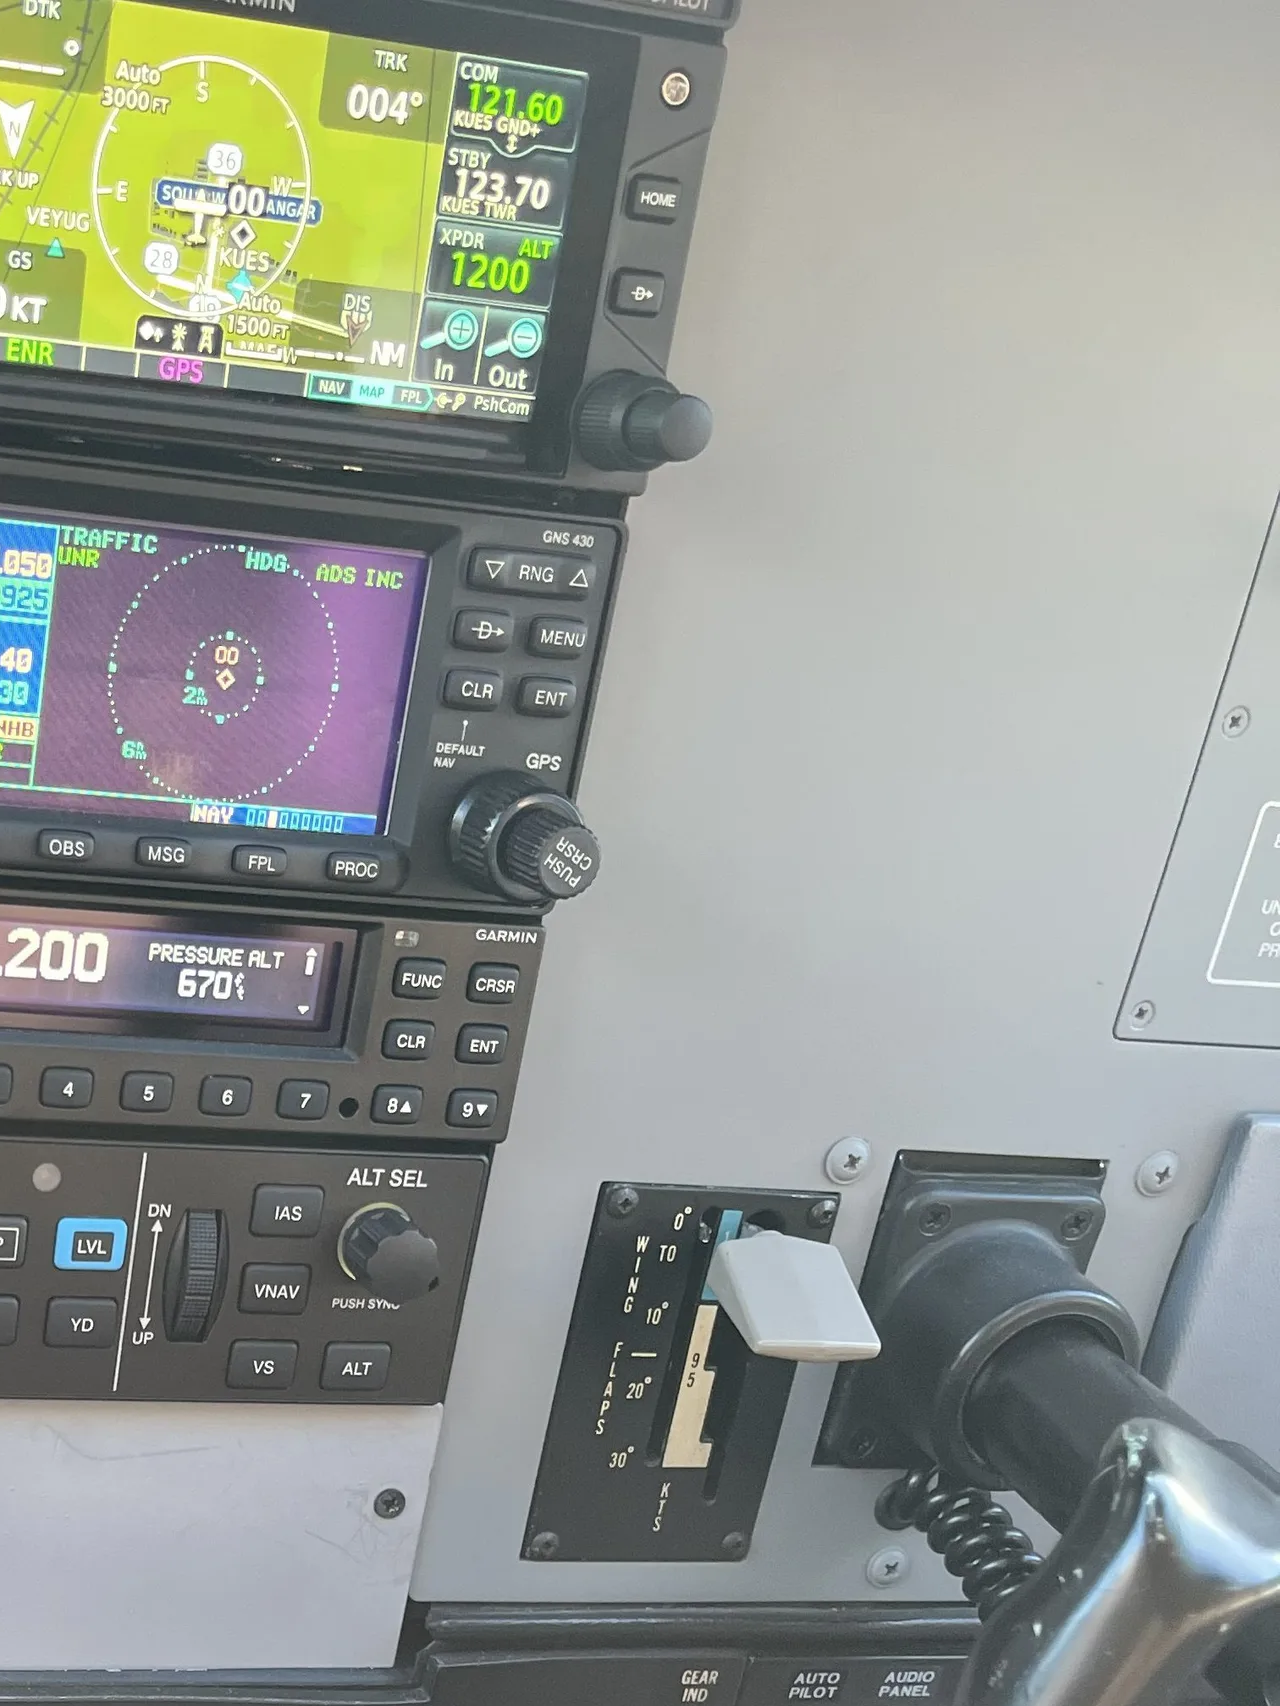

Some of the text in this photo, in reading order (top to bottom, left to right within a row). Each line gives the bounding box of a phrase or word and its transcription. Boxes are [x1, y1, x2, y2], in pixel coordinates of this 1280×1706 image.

[374, 49, 407, 72] TRK
[116, 61, 161, 85] Auto
[461, 61, 498, 83] COM
[347, 83, 423, 126] 004°
[468, 82, 563, 126] 121.60
[448, 148, 490, 169] STBY
[16, 170, 39, 190] UP
[641, 191, 676, 207] HOME
[27, 206, 90, 232] VEYUG
[451, 250, 529, 294] 1200
[239, 294, 280, 314] Auto
[6, 338, 54, 366] ENR
[159, 358, 204, 384] GPS
[62, 525, 158, 555] TRAFFIC
[543, 530, 594, 548] GNS 430
[59, 545, 100, 568] UNR
[519, 564, 554, 583] RNG
[541, 629, 585, 648] MENU
[461, 681, 493, 699] CLR
[535, 690, 567, 707] ENT
[526, 753, 562, 772] GPS
[50, 839, 85, 857] OBS
[148, 846, 185, 863] MSG
[248, 855, 275, 872] FPL
[335, 861, 378, 878] PROC
[475, 928, 538, 944] GARMIN
[148, 942, 285, 970] PRESSURE ALT
[401, 973, 442, 990] FUNC
[475, 978, 516, 994] CRSR
[396, 1034, 426, 1050] CLR
[470, 1038, 499, 1054] ENT
[347, 1168, 428, 1188] ALT SEL
[624, 1236, 650, 1313] WING
[254, 1284, 300, 1300] VNAV
[341, 1362, 372, 1376] ALT
[596, 1341, 624, 1435] FLAPS
[652, 1482, 670, 1532] KTS
[681, 1670, 719, 1686] GEAR
[794, 1673, 841, 1685] AUTO
[884, 1671, 936, 1683] AUDIO
[788, 1687, 838, 1699] PILOT
[878, 1685, 930, 1697] PANEL
